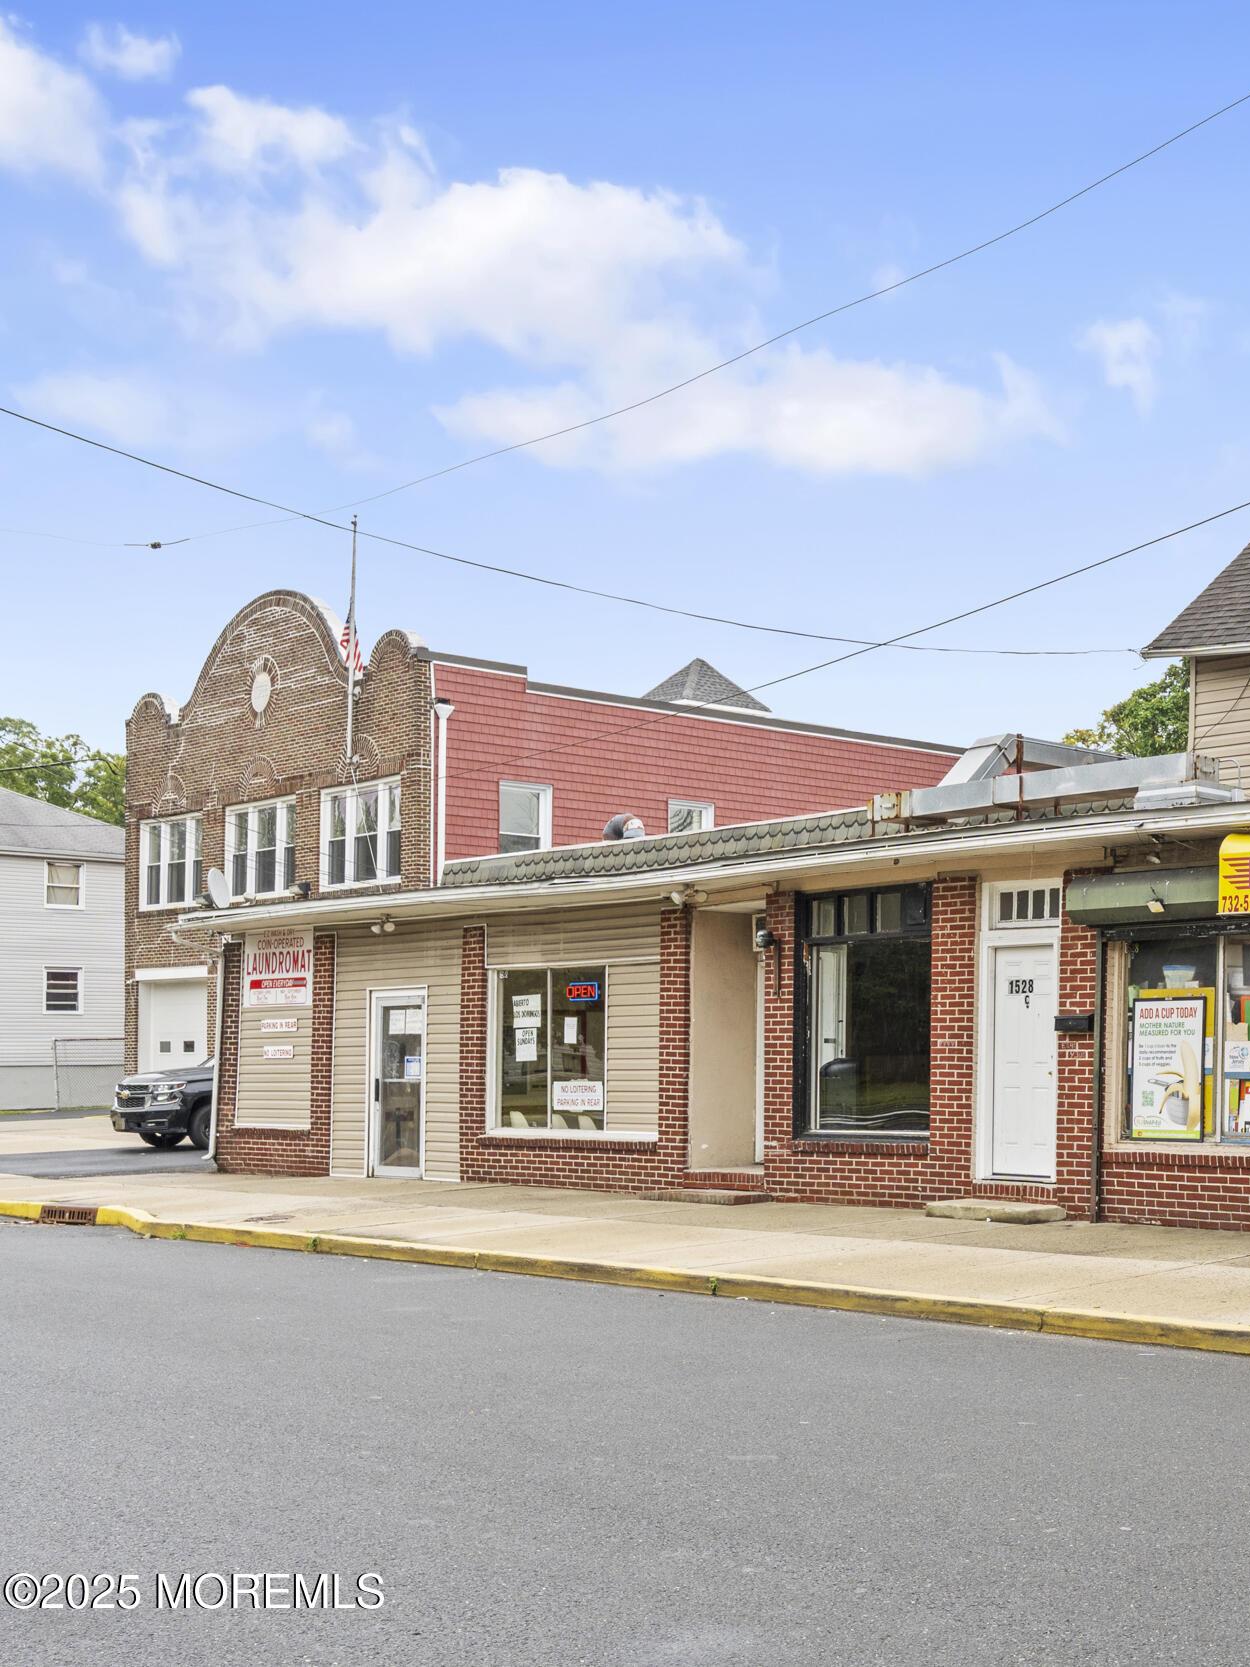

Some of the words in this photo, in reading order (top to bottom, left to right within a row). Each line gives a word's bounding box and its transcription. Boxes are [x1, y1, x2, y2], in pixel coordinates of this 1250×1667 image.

[258, 936, 304, 950] COIN-OPERATED
[246, 949, 312, 976] LAUNDROMAT
[566, 985, 596, 998] OPEN
[1008, 979, 1034, 994] 1528
[1024, 995, 1030, 1005] C
[1139, 1008, 1154, 1019] ADD
[1155, 1008, 1160, 1019] A
[1161, 1008, 1175, 1019] CUP
[1176, 1007, 1198, 1018] TODAY
[261, 1021, 279, 1030] PARKING
[570, 1085, 597, 1093] LOITERING
[557, 1098, 579, 1106] PARKING
[587, 1098, 600, 1106] REAR
